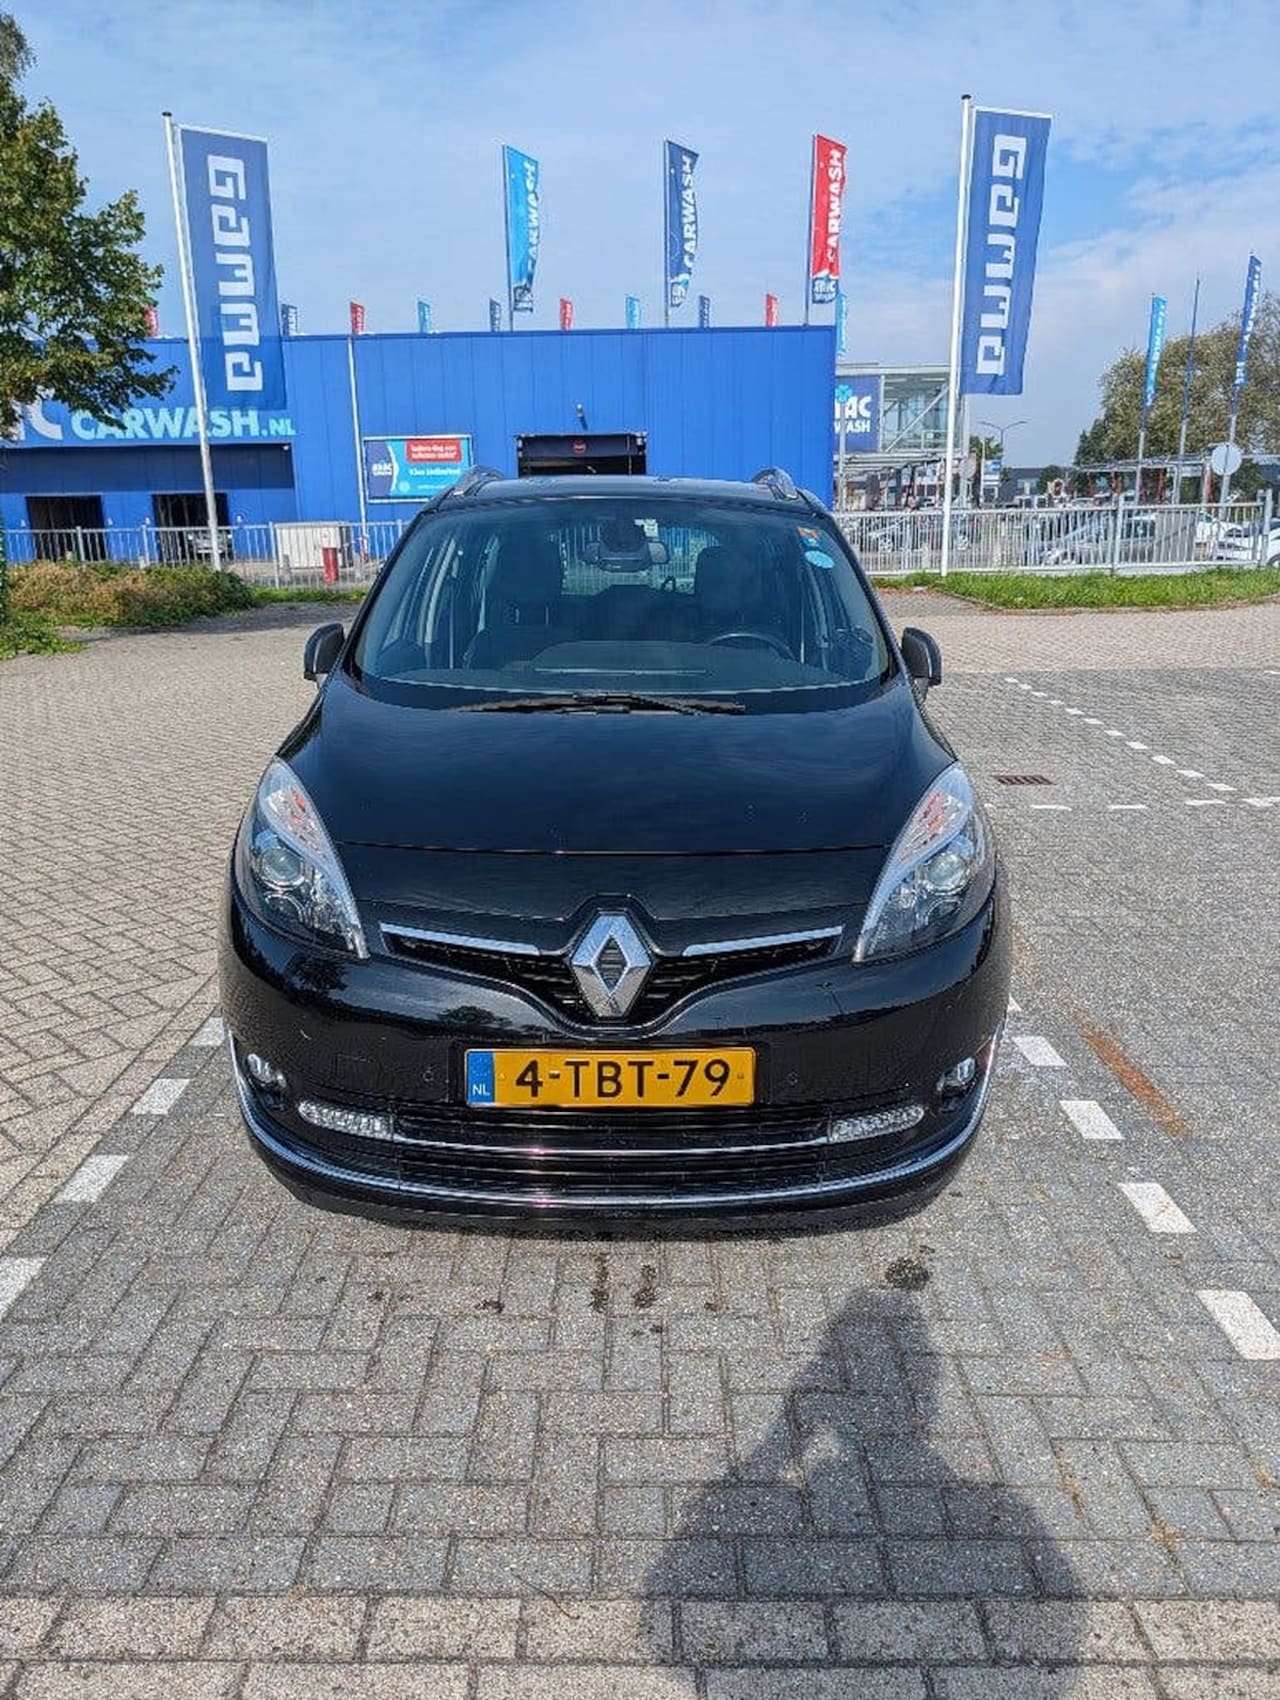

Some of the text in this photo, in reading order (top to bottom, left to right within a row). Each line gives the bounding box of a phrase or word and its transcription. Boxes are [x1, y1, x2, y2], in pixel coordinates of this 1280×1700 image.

[71, 407, 297, 441] CARWASH.NL
[472, 1083, 490, 1097] NL
[515, 1058, 731, 1098] 4-TBT-79
